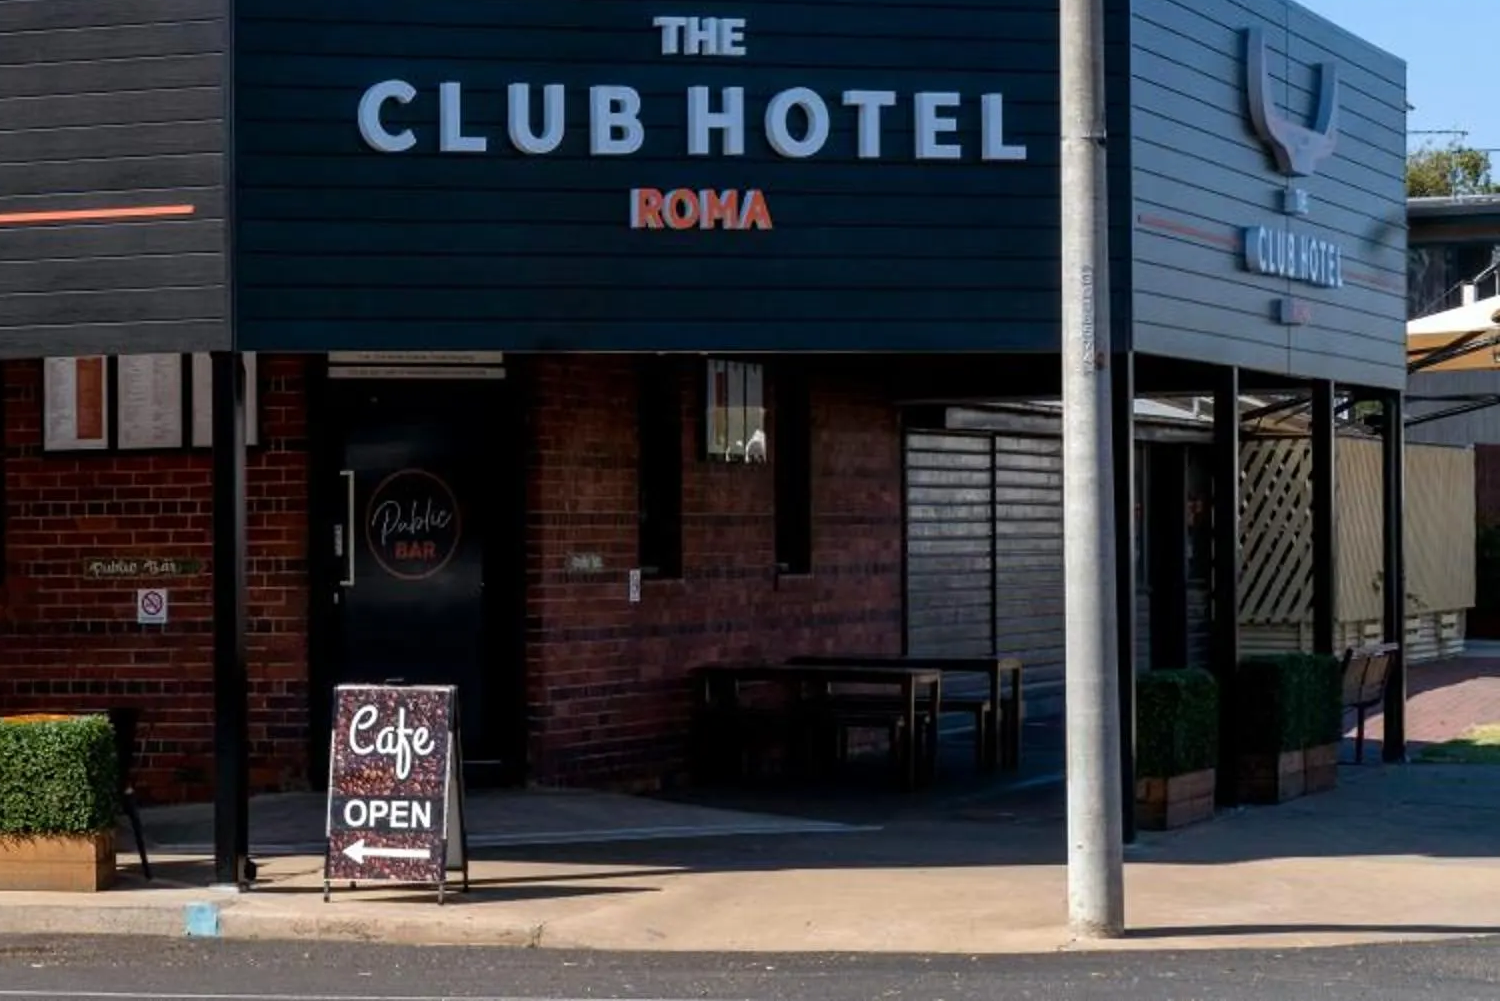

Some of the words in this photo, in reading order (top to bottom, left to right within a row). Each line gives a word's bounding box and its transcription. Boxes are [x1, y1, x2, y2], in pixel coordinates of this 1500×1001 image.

[653, 16, 747, 56] THE
[357, 79, 645, 155] CLUB
[687, 86, 1028, 160] HOTEL
[630, 187, 773, 230] ROMA
[1257, 226, 1296, 277] CLUB
[1301, 235, 1343, 288] HOTEL
[371, 496, 454, 546] Public
[394, 540, 437, 560] BAR
[349, 704, 435, 780] Cafe
[343, 799, 431, 829] OPEN
